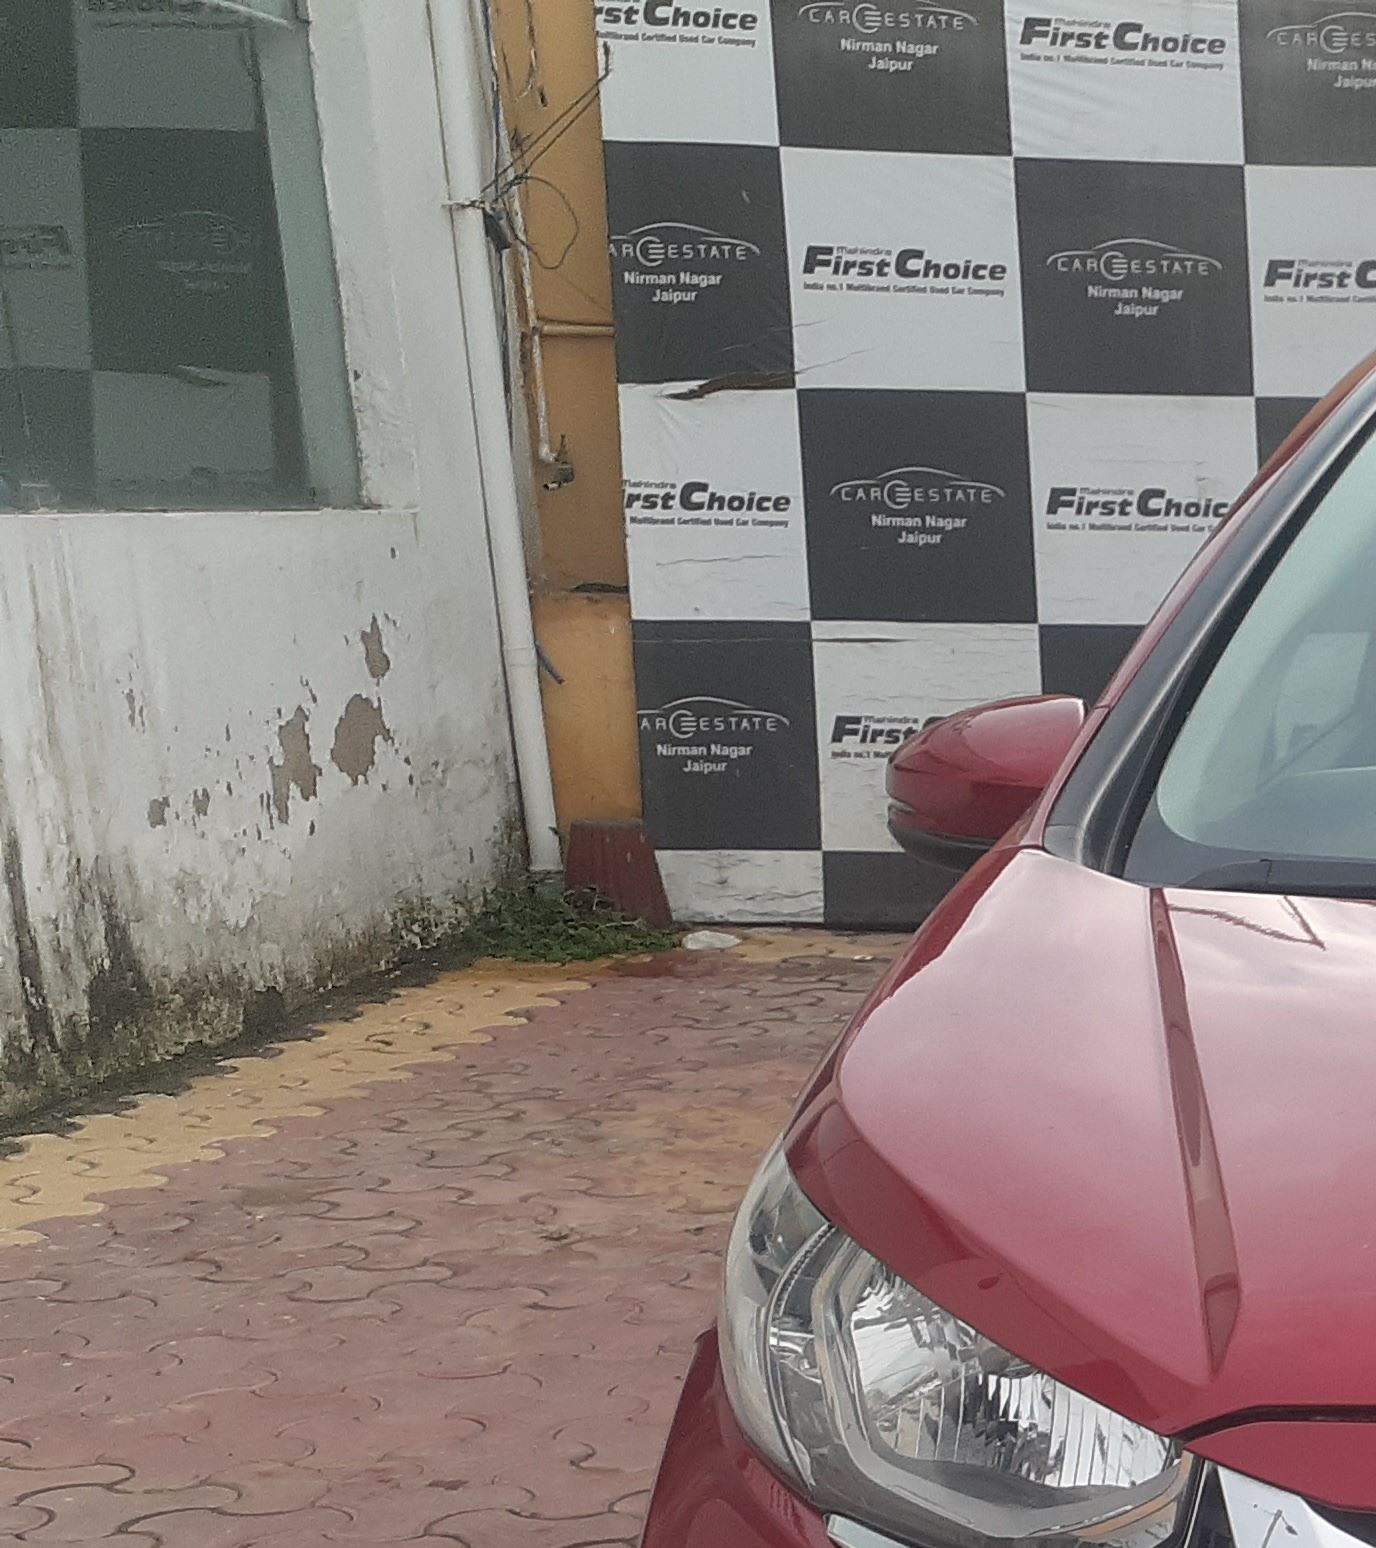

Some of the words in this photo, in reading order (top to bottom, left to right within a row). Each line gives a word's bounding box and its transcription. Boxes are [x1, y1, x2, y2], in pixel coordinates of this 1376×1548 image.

[809, 8, 850, 24] CAR
[884, 12, 964, 30] ESTATE
[1019, 17, 1109, 49] First
[1113, 22, 1226, 55] Choice
[1276, 32, 1317, 46] CAR
[841, 38, 892, 52] Nirman
[896, 40, 939, 57] Nagar
[868, 57, 914, 72] Jaipur
[1307, 58, 1358, 72] Nirman
[609, 243, 635, 258] AR
[668, 244, 747, 260] ESTATE
[803, 245, 891, 277] First
[895, 249, 1007, 280] Choice
[1057, 257, 1098, 272] CAR
[1130, 260, 1209, 275] ESTATE
[623, 271, 676, 285] Nirman
[680, 271, 722, 287] Nagar
[1263, 259, 1352, 288] First
[652, 289, 698, 304] Jaipur
[1087, 285, 1139, 298] Nirman
[1142, 286, 1184, 302] Nagar
[1114, 302, 1159, 317] Jaipur
[625, 491, 676, 510] rst
[679, 481, 791, 512] Choice
[841, 487, 880, 501] CAR
[914, 488, 992, 503] ESTATE
[1046, 487, 1134, 516] First
[1136, 488, 1230, 518] Choic
[871, 514, 922, 527] Nirman
[925, 515, 967, 530] Nagar
[898, 531, 942, 546] Jaipur
[640, 717, 667, 731] AR
[699, 717, 777, 732] ESTATE
[656, 744, 707, 756] Nirman
[710, 744, 752, 758] Nagar
[682, 760, 727, 774] Jaipur
